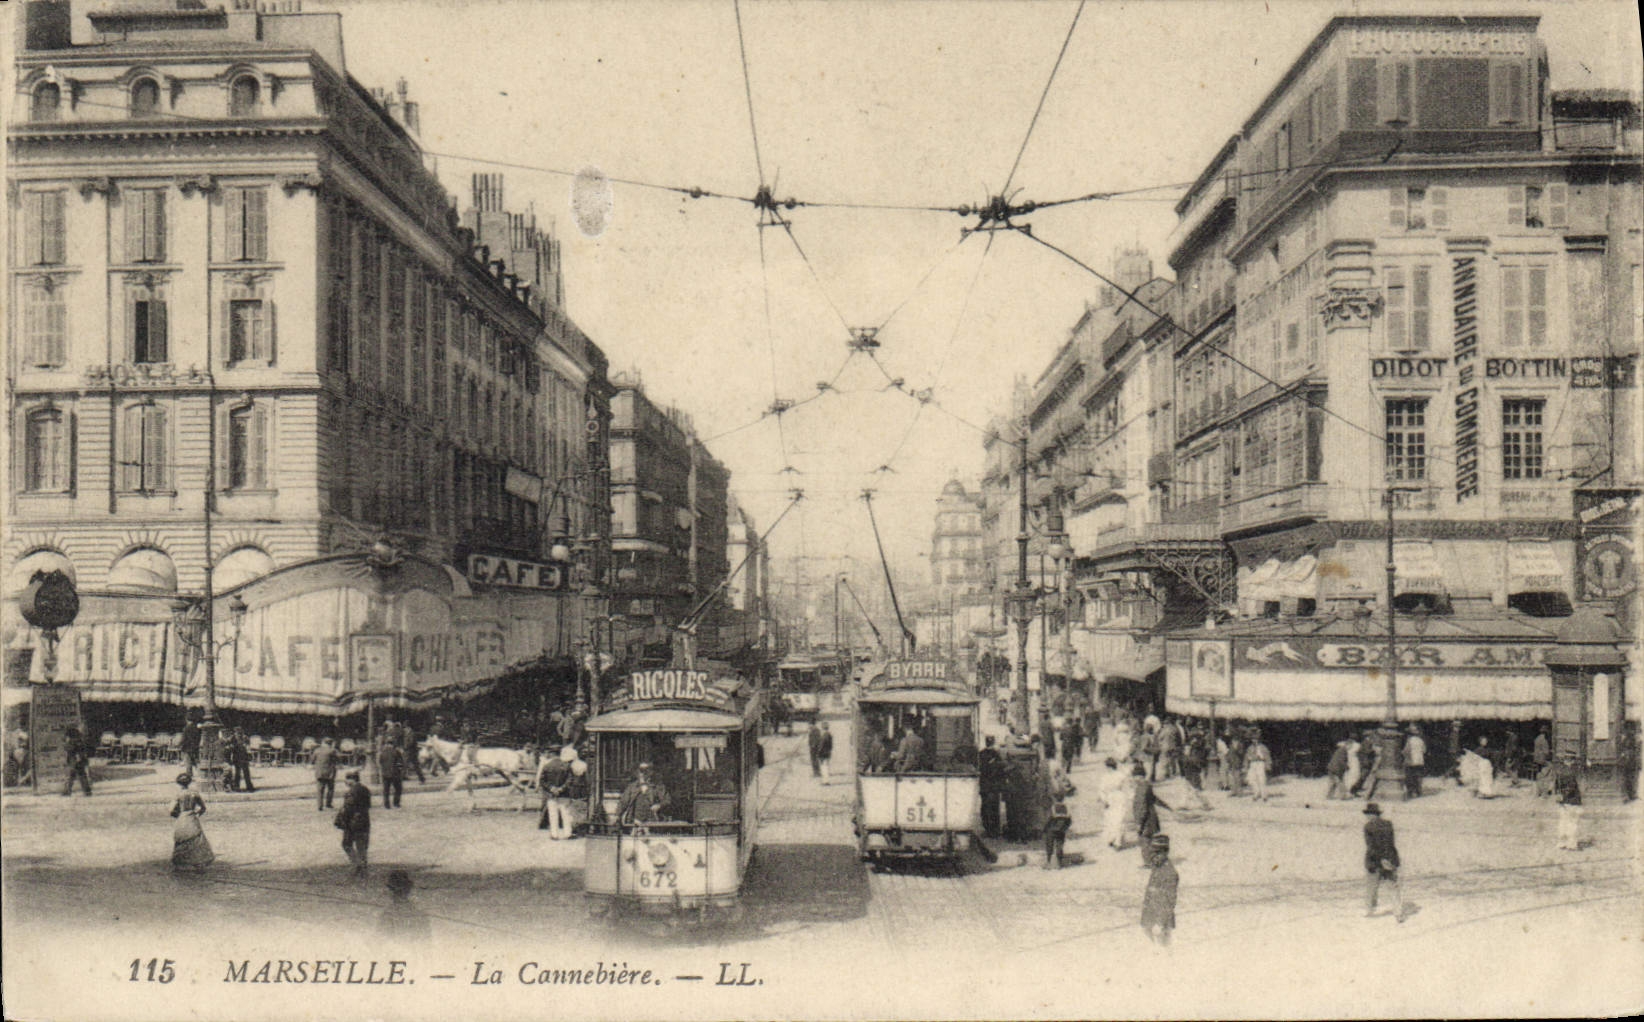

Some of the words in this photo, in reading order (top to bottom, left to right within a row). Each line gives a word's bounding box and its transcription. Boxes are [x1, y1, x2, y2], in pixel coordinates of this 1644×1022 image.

[1453, 256, 1479, 367] ANNUAIRE
[1371, 358, 1448, 378] DIDOT
[1485, 357, 1567, 378] BOTTIN
[1454, 386, 1480, 505] COMMERCE
[236, 635, 345, 681] CAFE
[1336, 647, 1446, 666] BAR
[889, 662, 946, 679] BYRRH
[906, 807, 937, 823] 514
[639, 871, 679, 888] 672
